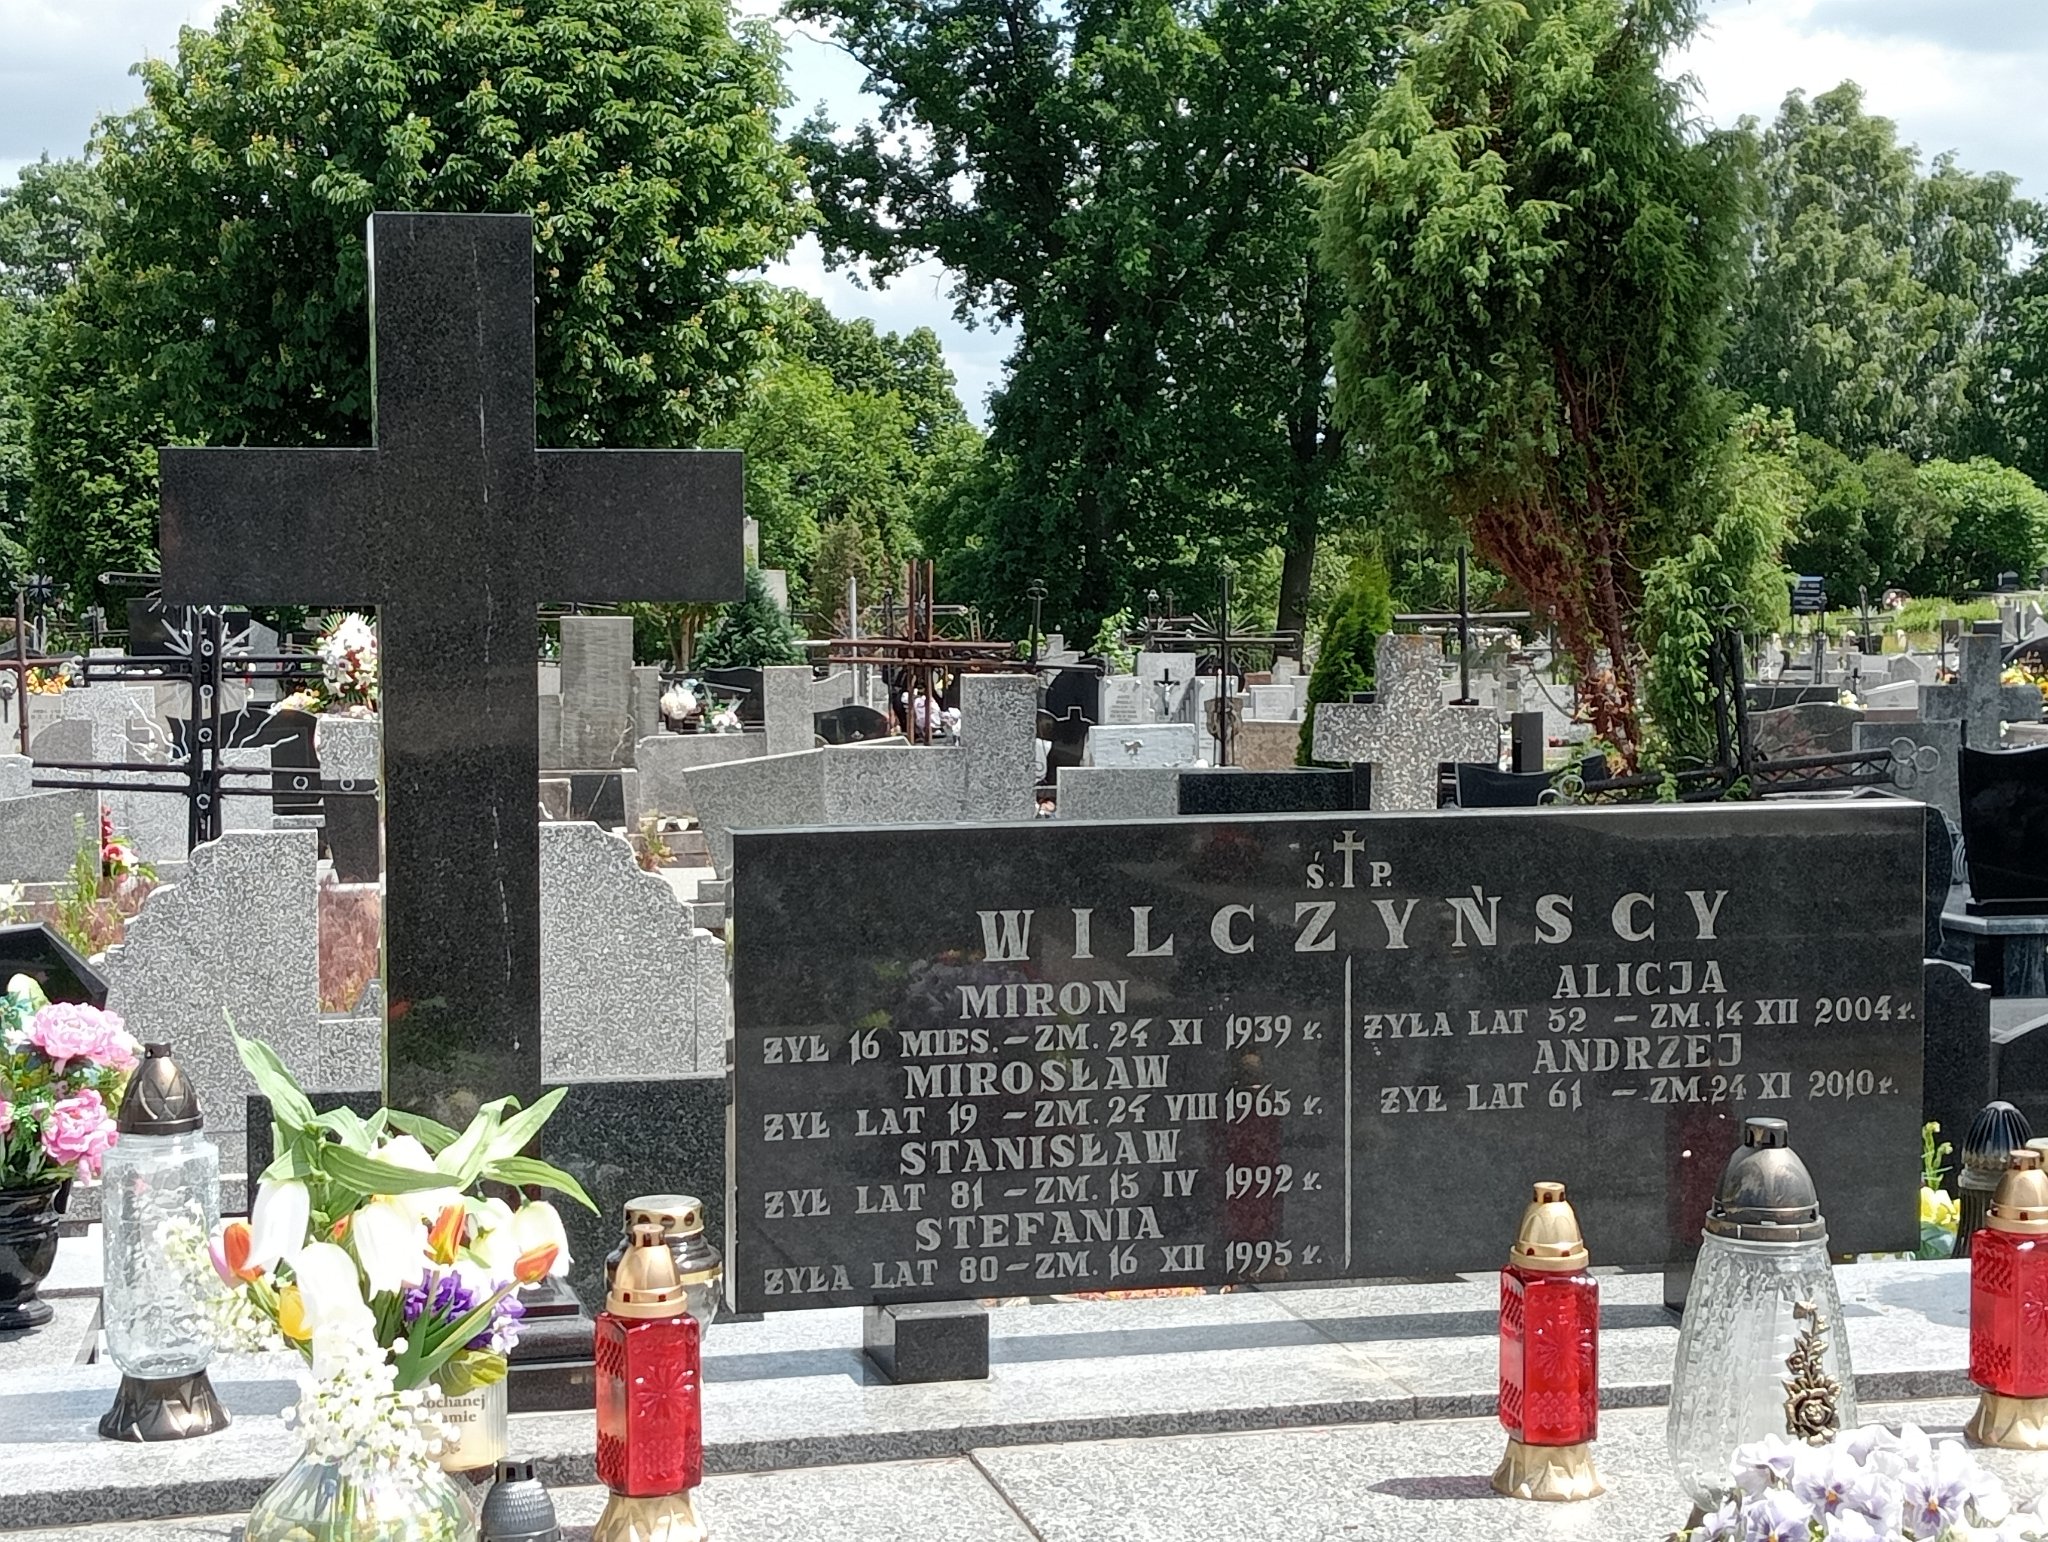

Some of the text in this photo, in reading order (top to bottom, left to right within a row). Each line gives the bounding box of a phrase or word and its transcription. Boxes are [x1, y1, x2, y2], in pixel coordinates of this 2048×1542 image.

[957, 980, 1129, 1020] MIRON
[1552, 960, 1727, 999] ALICJA
[1468, 1008, 1529, 1036] LAT
[1547, 1006, 1588, 1034] 52
[1715, 998, 1744, 1029] 14
[1753, 998, 1800, 1026] XII
[1815, 994, 1892, 1027] 2004
[848, 1027, 880, 1066] 16
[1108, 1018, 1153, 1053] 24
[1168, 1019, 1203, 1046] XI
[1226, 1013, 1292, 1050] 1939
[1532, 1032, 1742, 1074] ANDRZEJ
[903, 1054, 1170, 1099] MIROSŁAW
[1466, 1082, 1529, 1111] LAT
[1549, 1077, 1583, 1112] 61
[1711, 1074, 1747, 1105] 24
[1757, 1072, 1792, 1100] XI
[1808, 1069, 1875, 1102] 2010
[855, 1106, 926, 1137] LAT
[948, 1101, 978, 1136] 19
[1107, 1093, 1151, 1128] 24
[1164, 1092, 1218, 1122] VIII
[1225, 1084, 1292, 1124] 1965
[900, 1128, 1181, 1176] STANISŁAW
[855, 1183, 926, 1214] LAT
[951, 1176, 984, 1212] 81
[1109, 1168, 1140, 1205] 15
[1162, 1169, 1199, 1198] IV
[1225, 1162, 1293, 1200] 1992
[915, 1206, 1164, 1252] STEFANIA
[871, 1259, 938, 1289] LAT
[959, 1255, 999, 1283] 80
[1109, 1243, 1138, 1280] 16
[1159, 1244, 1206, 1273] XII
[1225, 1239, 1293, 1275] 1995
